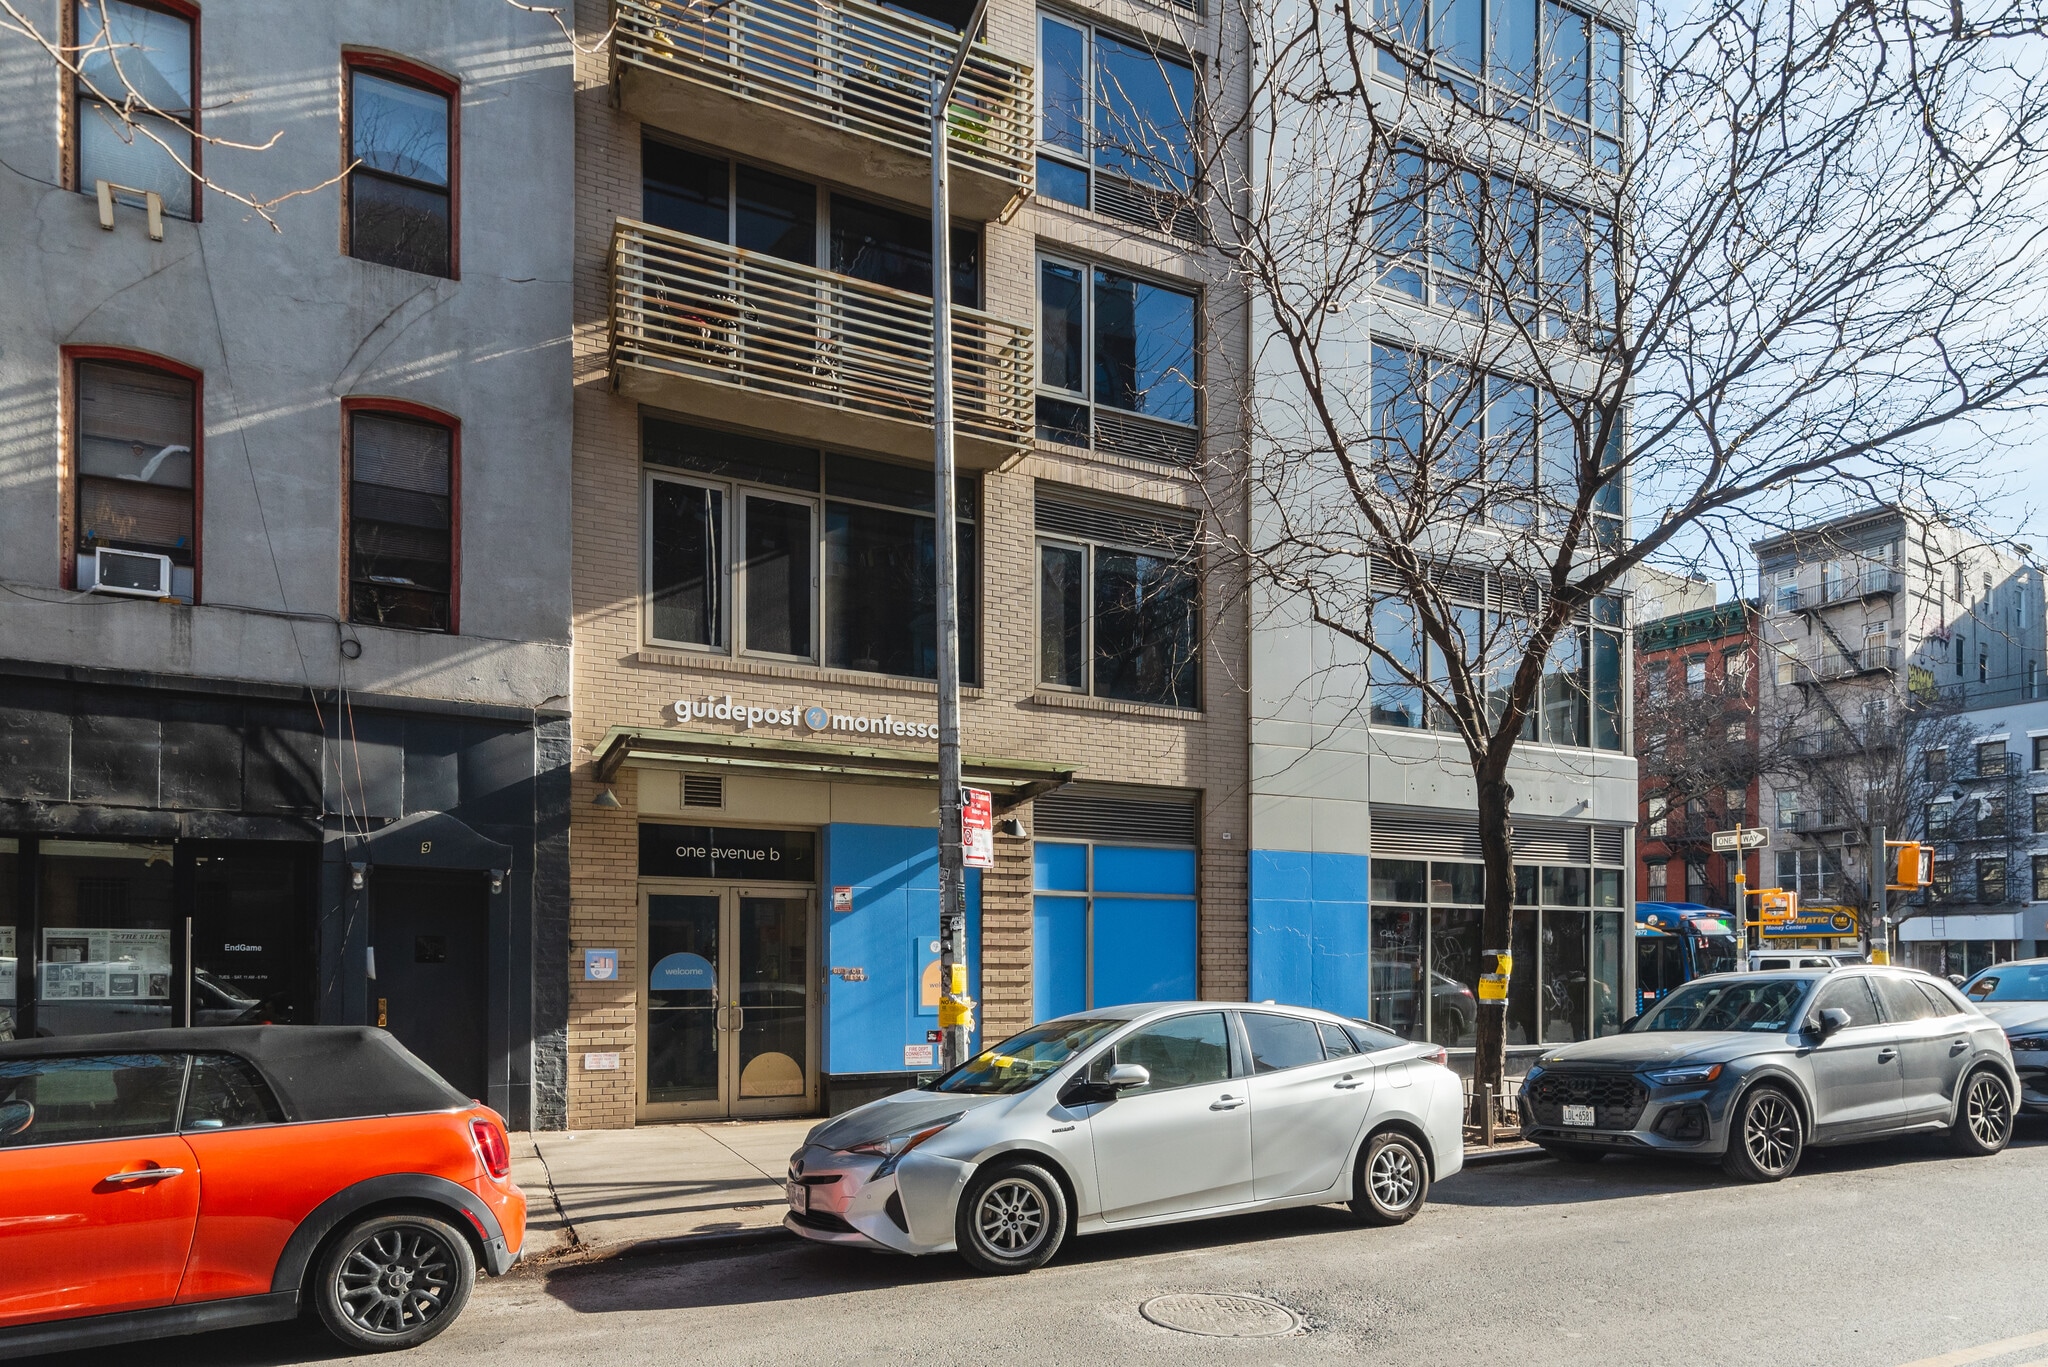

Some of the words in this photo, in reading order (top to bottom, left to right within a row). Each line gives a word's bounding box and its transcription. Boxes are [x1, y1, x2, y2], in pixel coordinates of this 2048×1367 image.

[674, 696, 800, 728] guidepost
[1718, 837, 1734, 845] ONE
[1742, 834, 1758, 842] WAY
[422, 843, 430, 852] 9
[675, 846, 706, 858] one
[710, 847, 765, 861] avenue
[770, 847, 780, 861] b
[224, 943, 262, 951] EndGame
[665, 967, 703, 975] welcome
[1579, 1111, 1592, 1121] 6581
